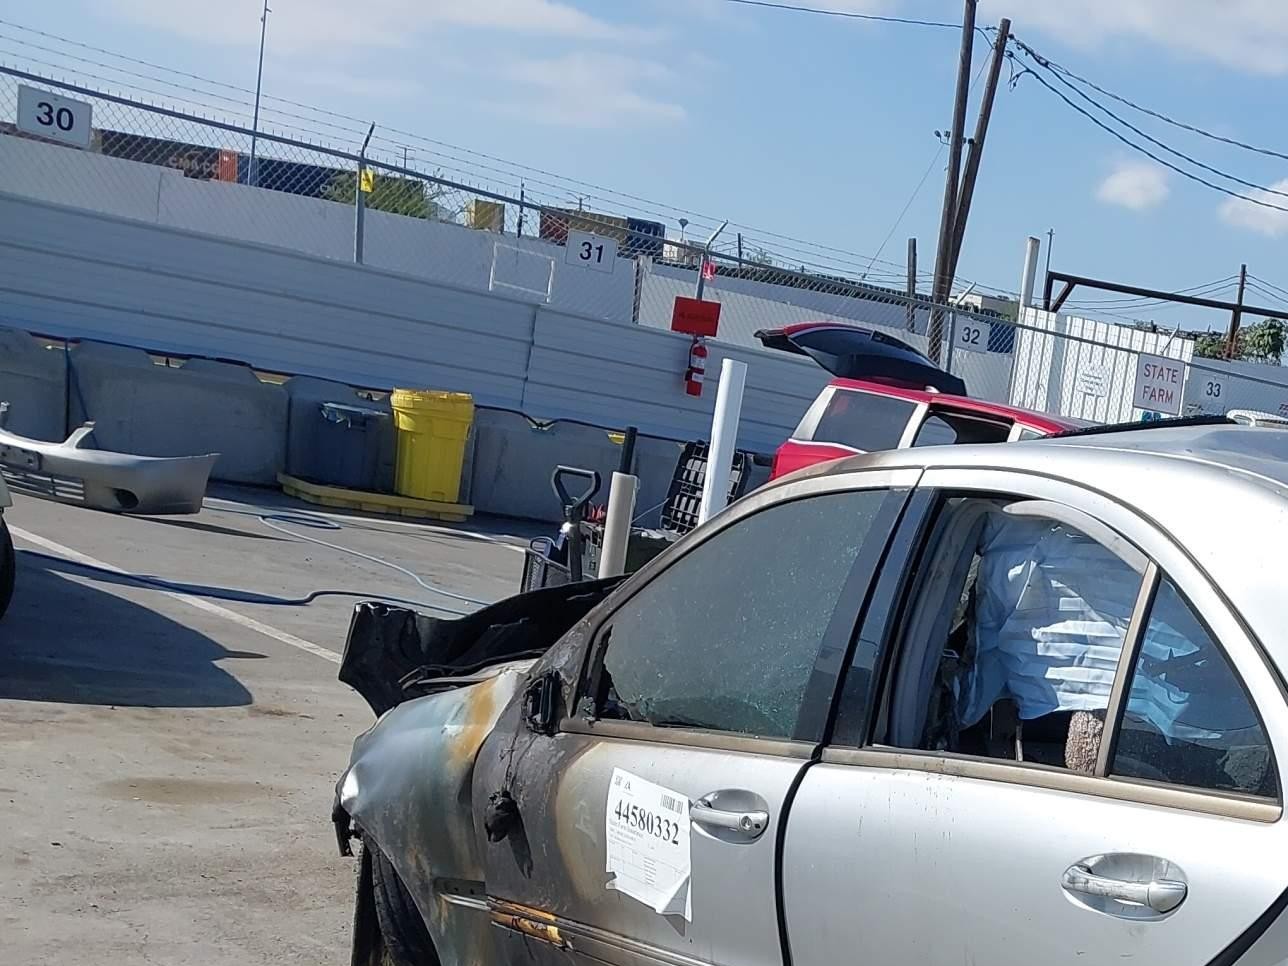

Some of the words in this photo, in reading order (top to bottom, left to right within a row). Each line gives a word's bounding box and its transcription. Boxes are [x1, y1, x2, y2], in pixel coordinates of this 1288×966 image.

[36, 102, 74, 131] 30
[579, 241, 604, 263] 31
[961, 326, 980, 345] 32
[1143, 363, 1179, 384] STATE
[1142, 385, 1174, 404] FARM
[1206, 381, 1221, 398] 33
[614, 799, 679, 846] 44580332
